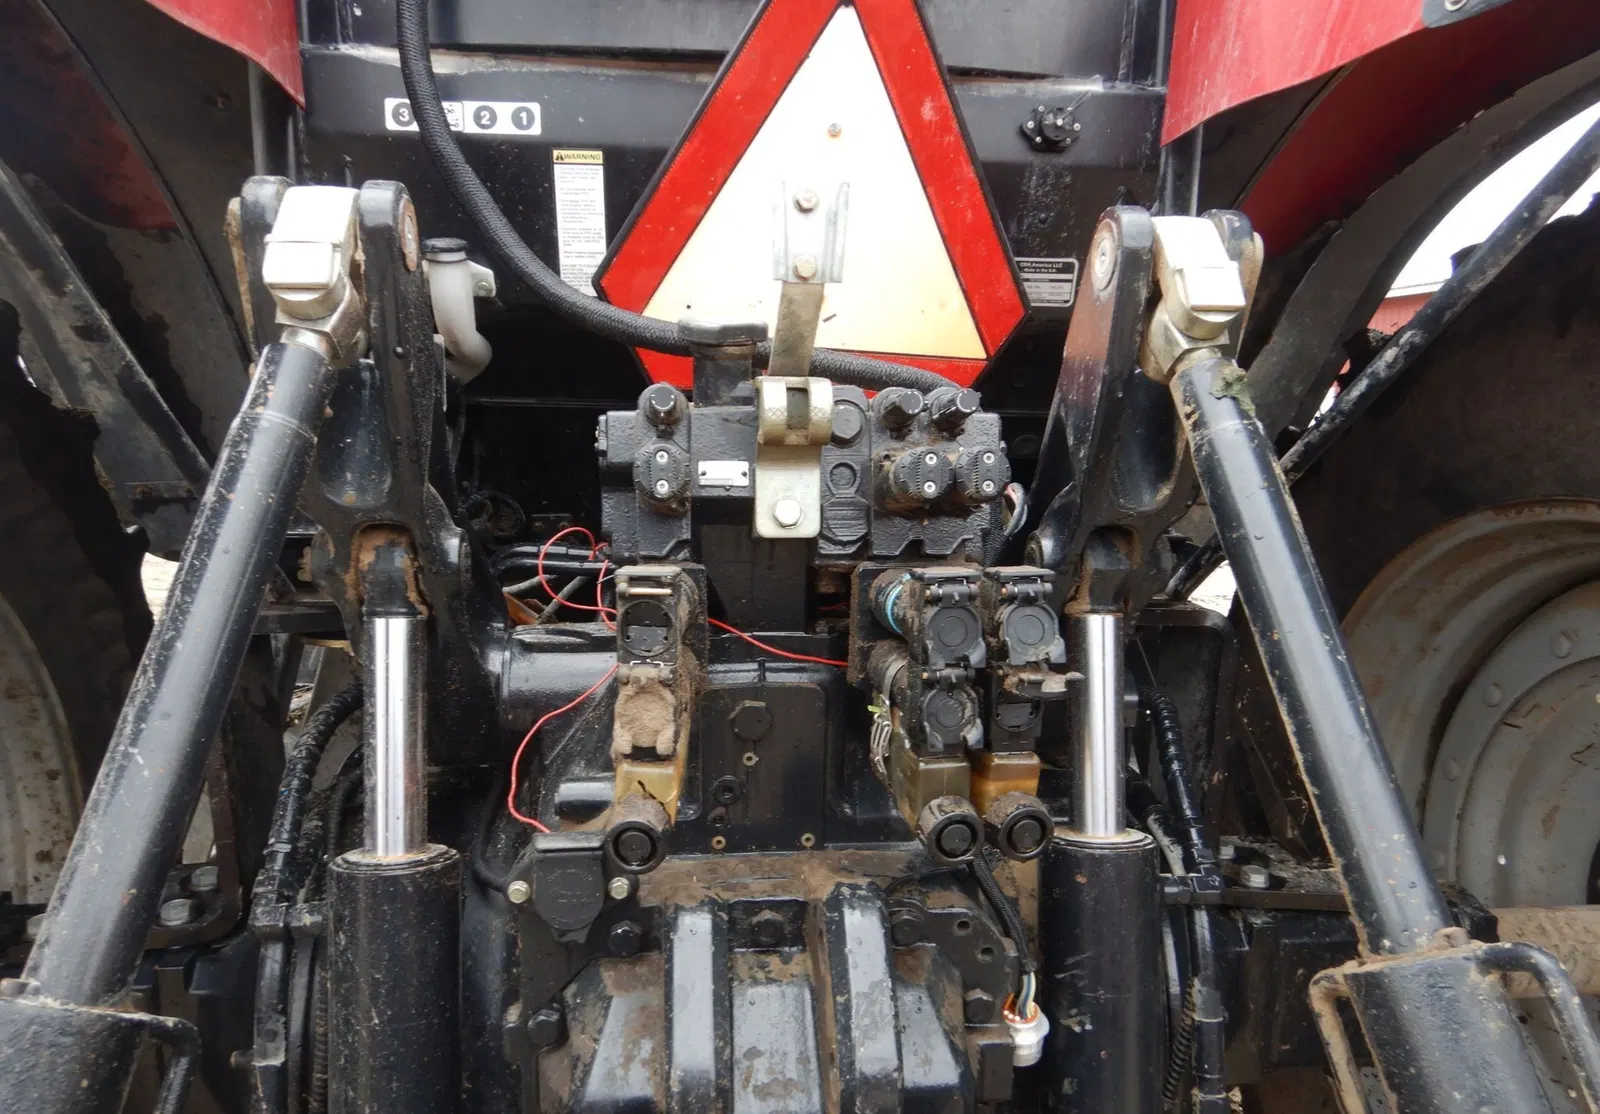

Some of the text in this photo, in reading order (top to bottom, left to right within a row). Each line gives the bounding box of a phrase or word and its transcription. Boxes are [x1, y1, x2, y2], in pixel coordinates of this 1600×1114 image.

[399, 107, 410, 122] 3
[479, 110, 528, 126] 2 1
